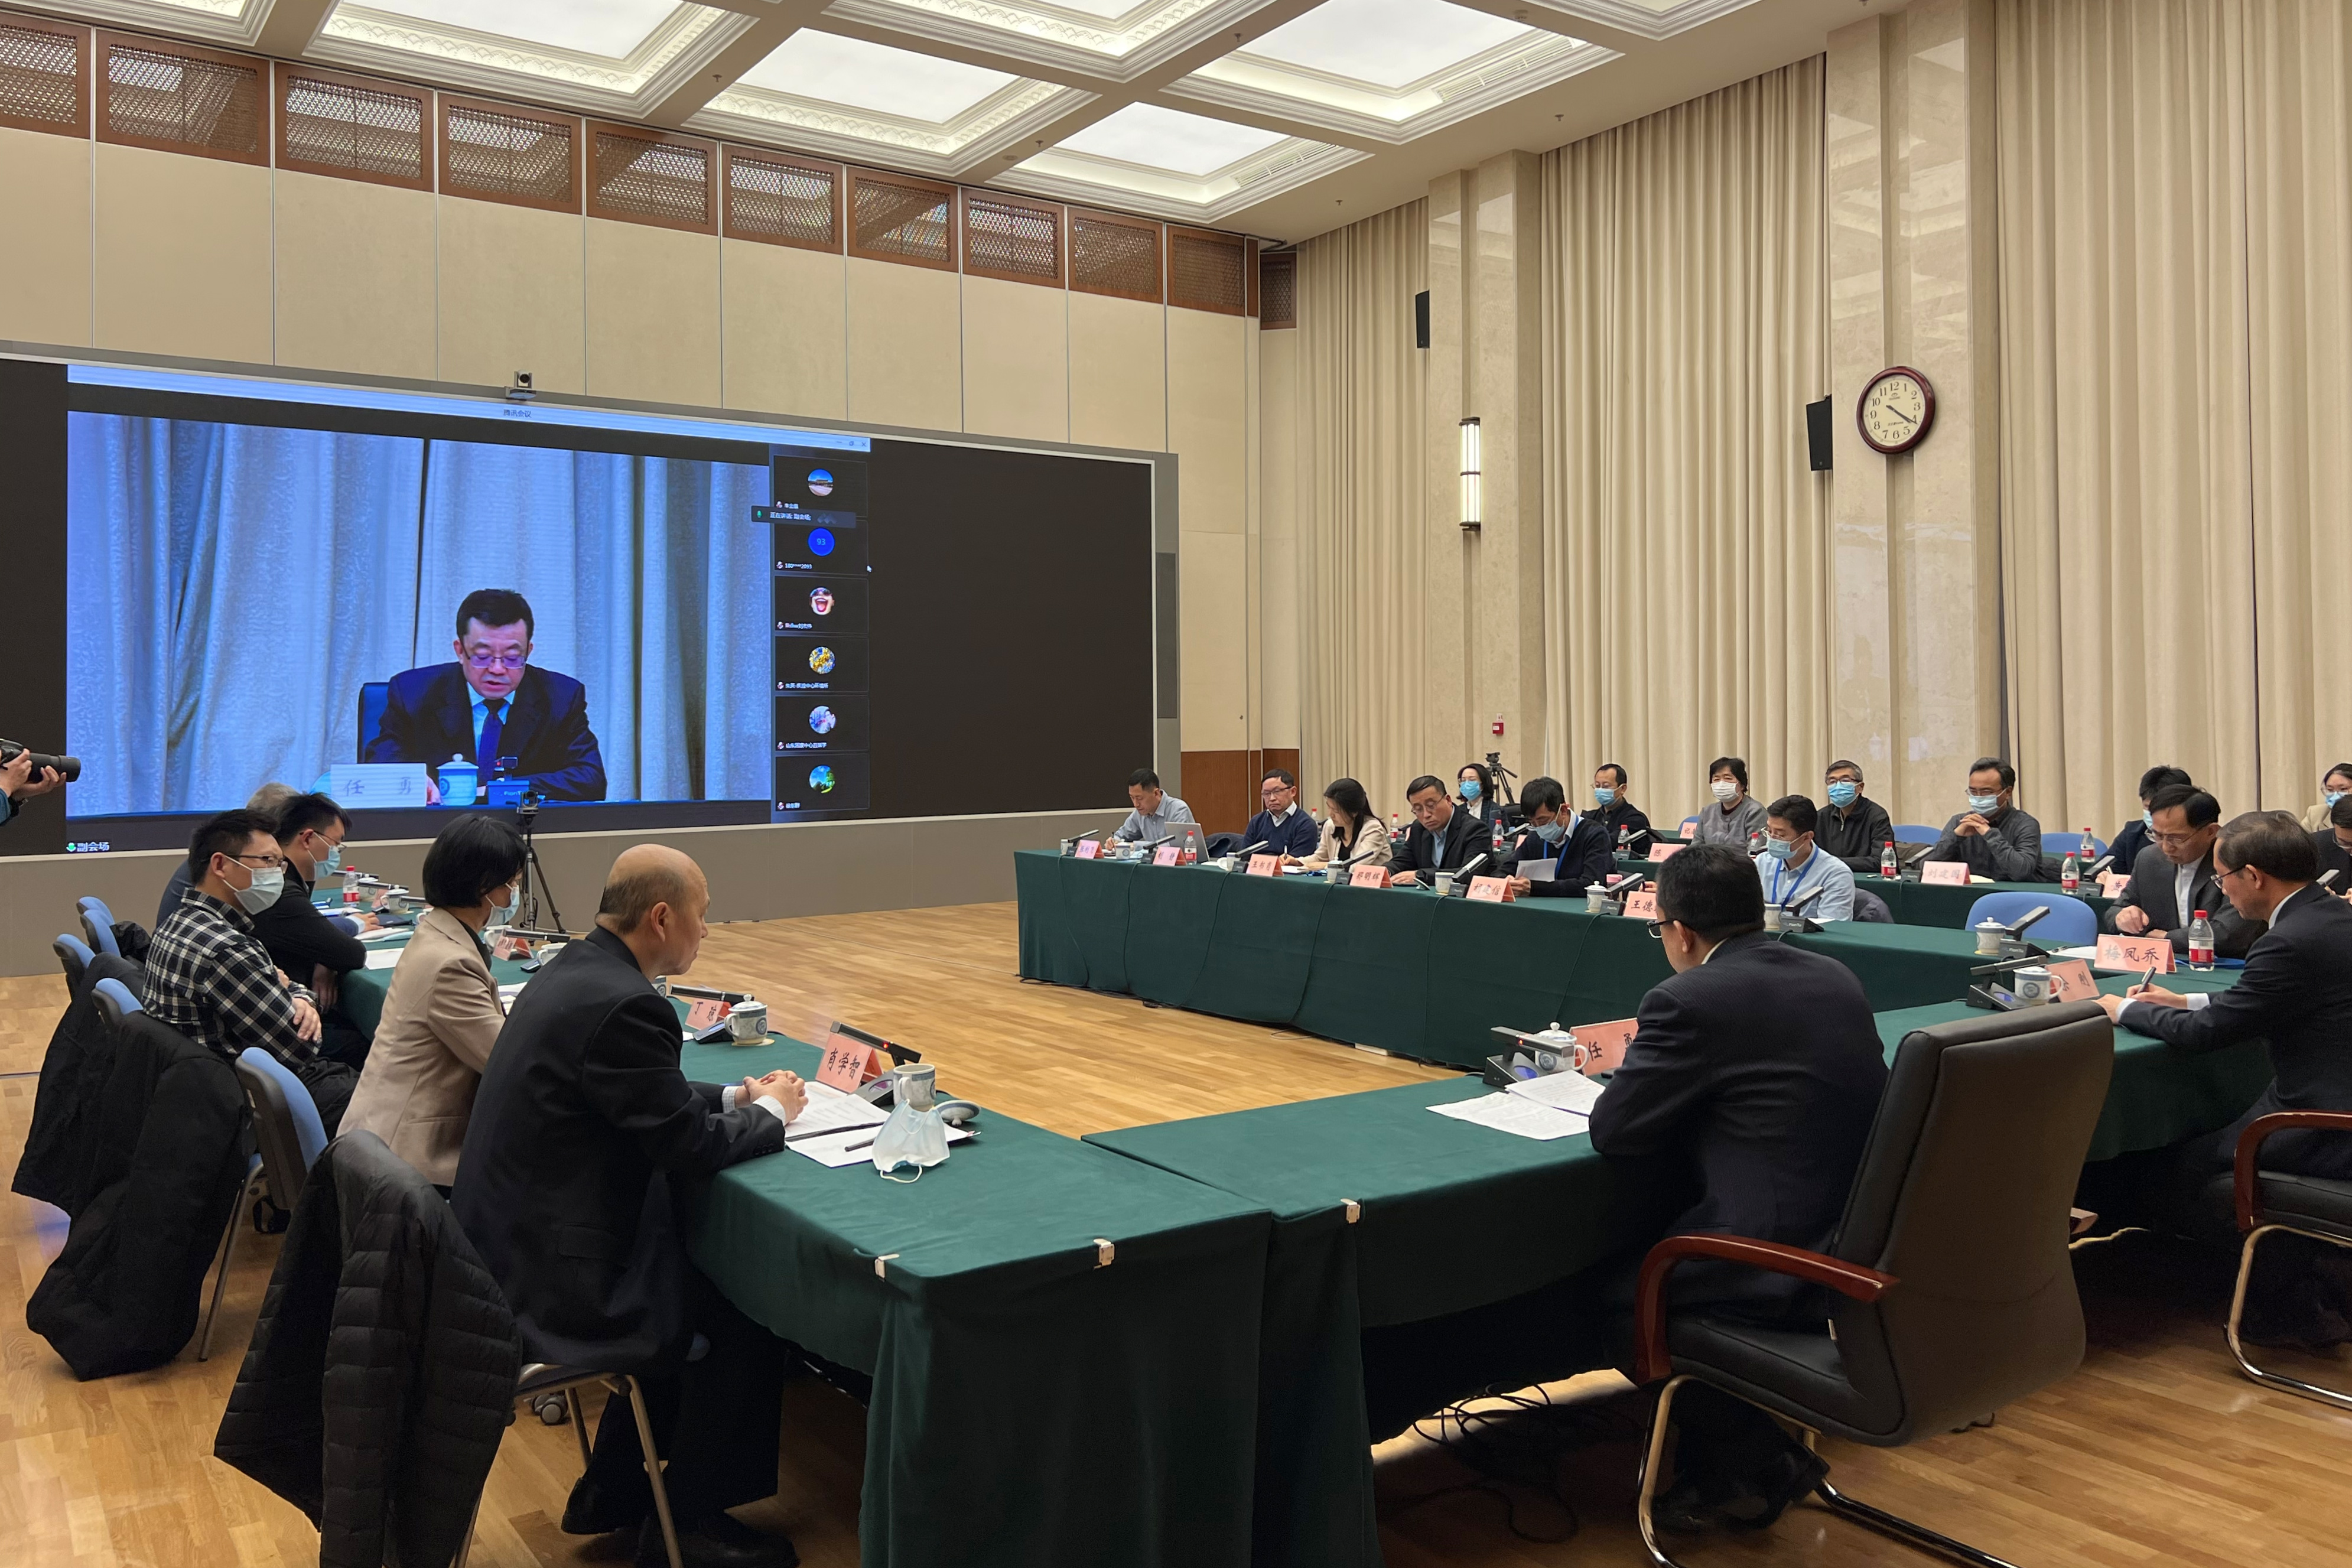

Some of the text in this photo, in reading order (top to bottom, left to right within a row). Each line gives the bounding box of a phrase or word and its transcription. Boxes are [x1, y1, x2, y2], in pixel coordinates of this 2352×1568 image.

[1890, 381, 1899, 391] 12
[1904, 383, 1907, 392] 1
[1879, 387, 1886, 396] 11
[1911, 391, 1917, 400] 2
[1872, 397, 1881, 407] 10
[1914, 402, 1921, 411] 3
[503, 409, 532, 419] 腾讯会议
[1870, 410, 1877, 419] 9
[1873, 421, 1881, 430] 8
[1903, 425, 1911, 435] 5
[1882, 430, 1889, 439] 7
[1892, 430, 1899, 439] 6
[77, 841, 110, 852] 副会场
[2104, 944, 2160, 965] 梅凤乔
[827, 1047, 860, 1080] 肖学智
